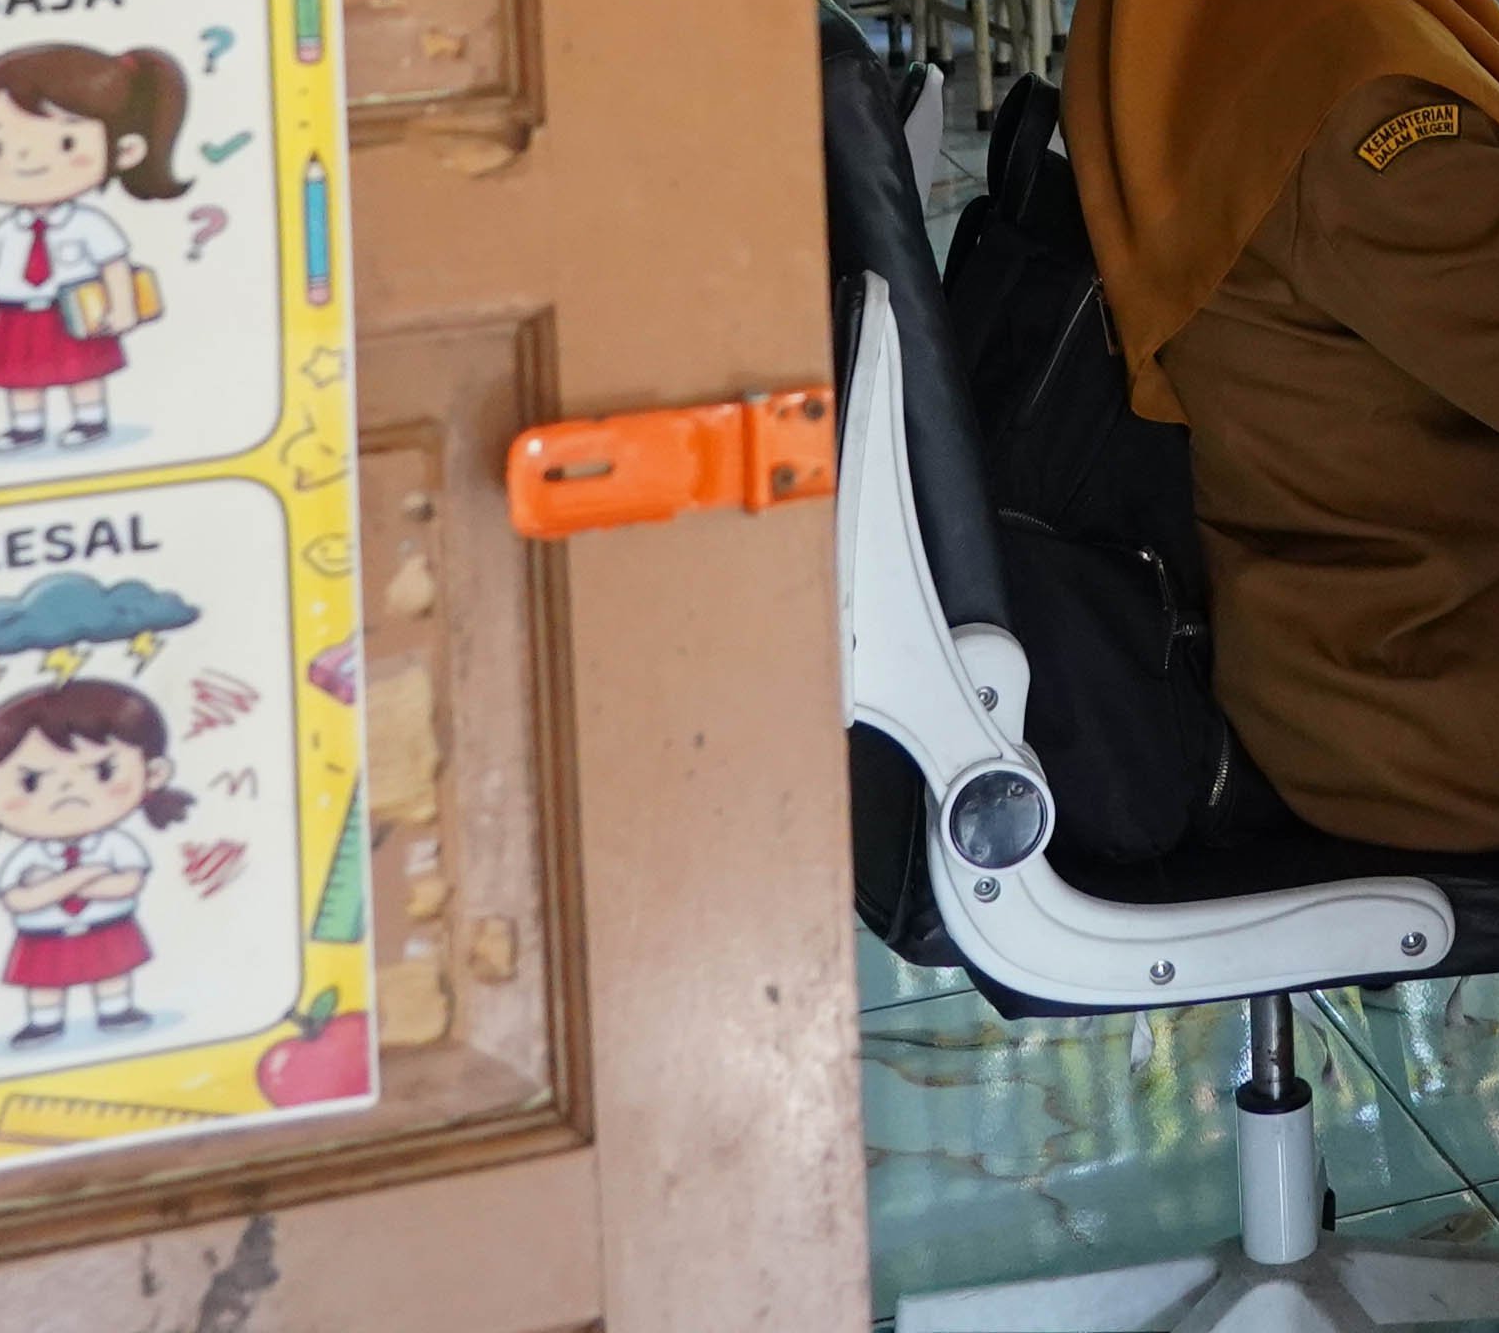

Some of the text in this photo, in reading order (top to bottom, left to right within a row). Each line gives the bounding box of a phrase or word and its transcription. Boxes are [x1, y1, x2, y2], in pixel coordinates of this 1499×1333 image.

[1363, 107, 1453, 156] KEMENTERIAN
[1374, 122, 1453, 165] DALAM NEGERI
